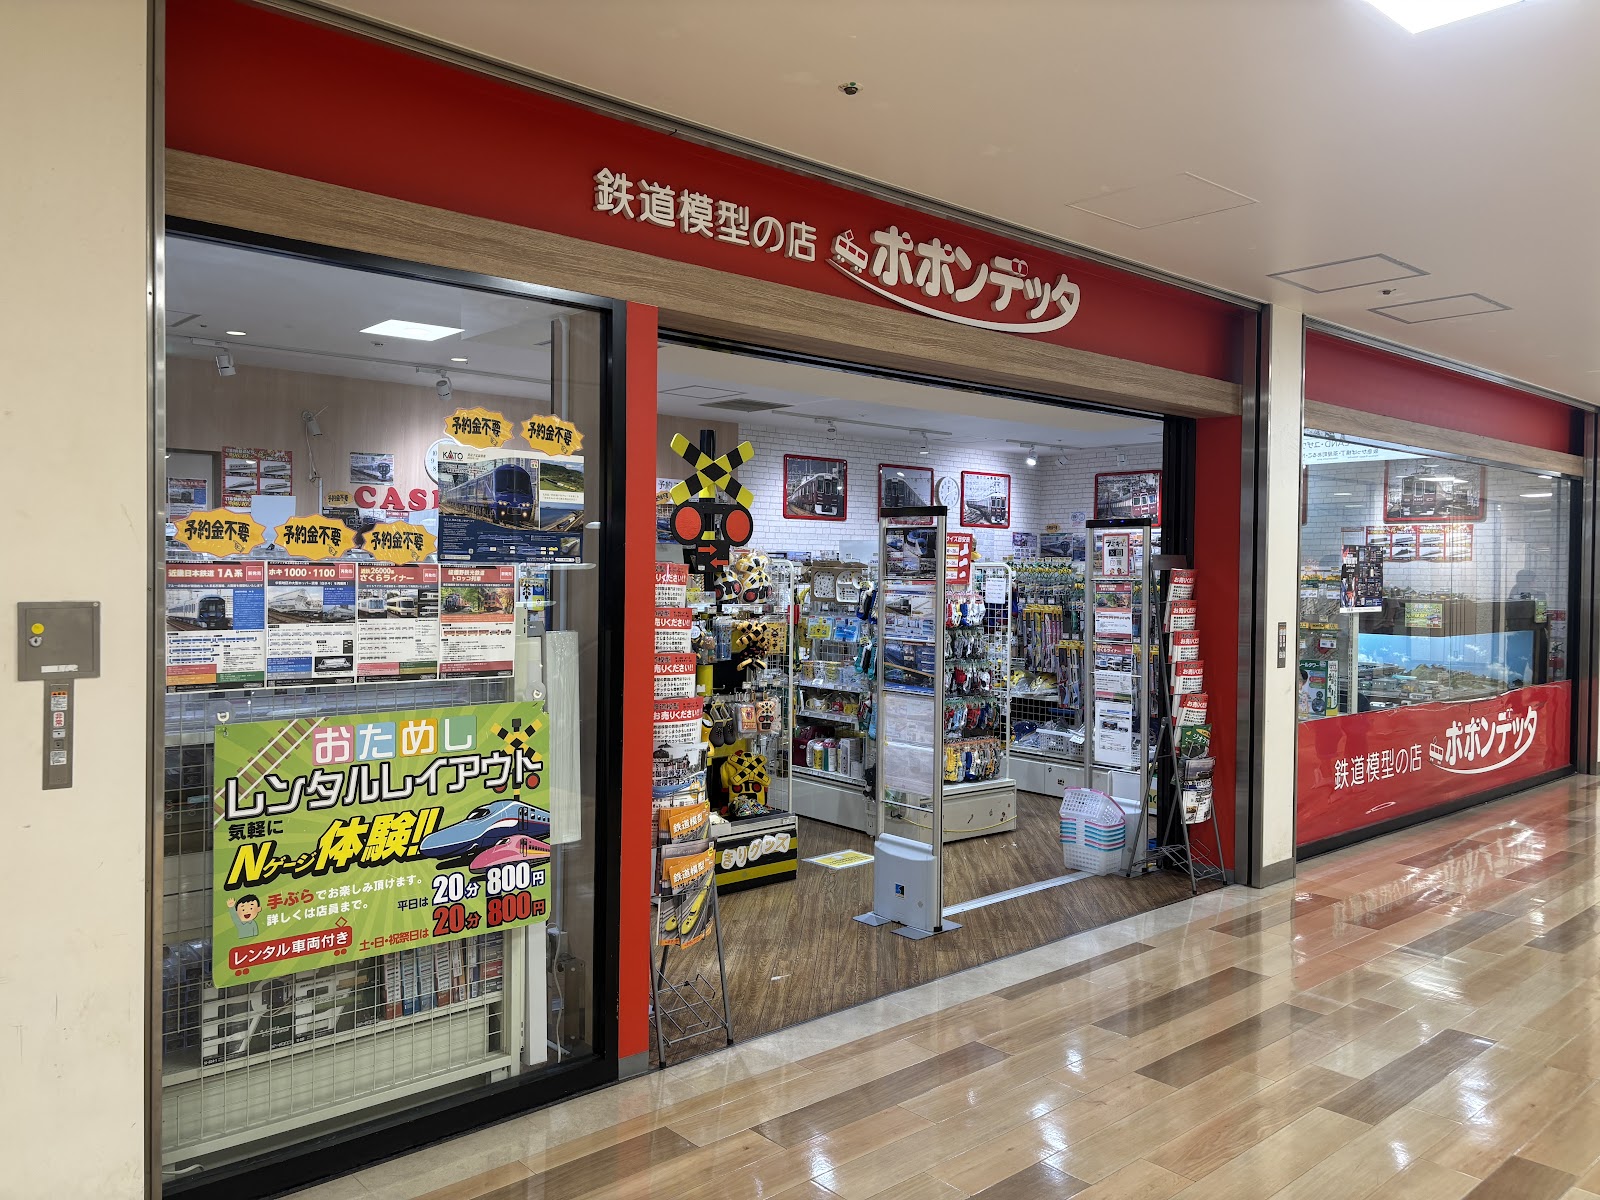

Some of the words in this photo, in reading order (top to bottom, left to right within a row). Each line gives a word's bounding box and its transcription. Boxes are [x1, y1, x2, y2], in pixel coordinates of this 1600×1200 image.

[594, 167, 817, 262] 鉄道模型の店
[870, 225, 1081, 322] ポポンデッタ
[452, 416, 502, 437] 予約金不要
[527, 421, 573, 446] 予約金不要
[442, 450, 464, 460] KATO
[184, 519, 250, 543] 予約金不要
[283, 524, 342, 547] 予約金不要
[370, 531, 424, 551] 予約金不要
[268, 568, 283, 576] ホキ
[284, 568, 336, 577] 1000・1100
[360, 574, 415, 582] さくらライナー
[314, 716, 474, 763] おためし
[1334, 744, 1423, 791] 鉄道模型の店
[1445, 706, 1538, 767] ポポンデッタ
[225, 749, 545, 820] レンタルレイアウト
[228, 818, 284, 842] 気軽に
[673, 860, 705, 883] 鉄道模型
[266, 875, 423, 910] 手ぶらでお楽しみ頂けます。
[397, 896, 430, 911] 平日は
[431, 873, 480, 906] 20分
[486, 863, 546, 898] 800円
[266, 902, 369, 926] 詳しくは店員まで。
[359, 927, 430, 952] 土・日・祝祭日は
[431, 905, 481, 938] 20分
[486, 892, 547, 928] 800円
[233, 929, 350, 966] レンタル車両付き
